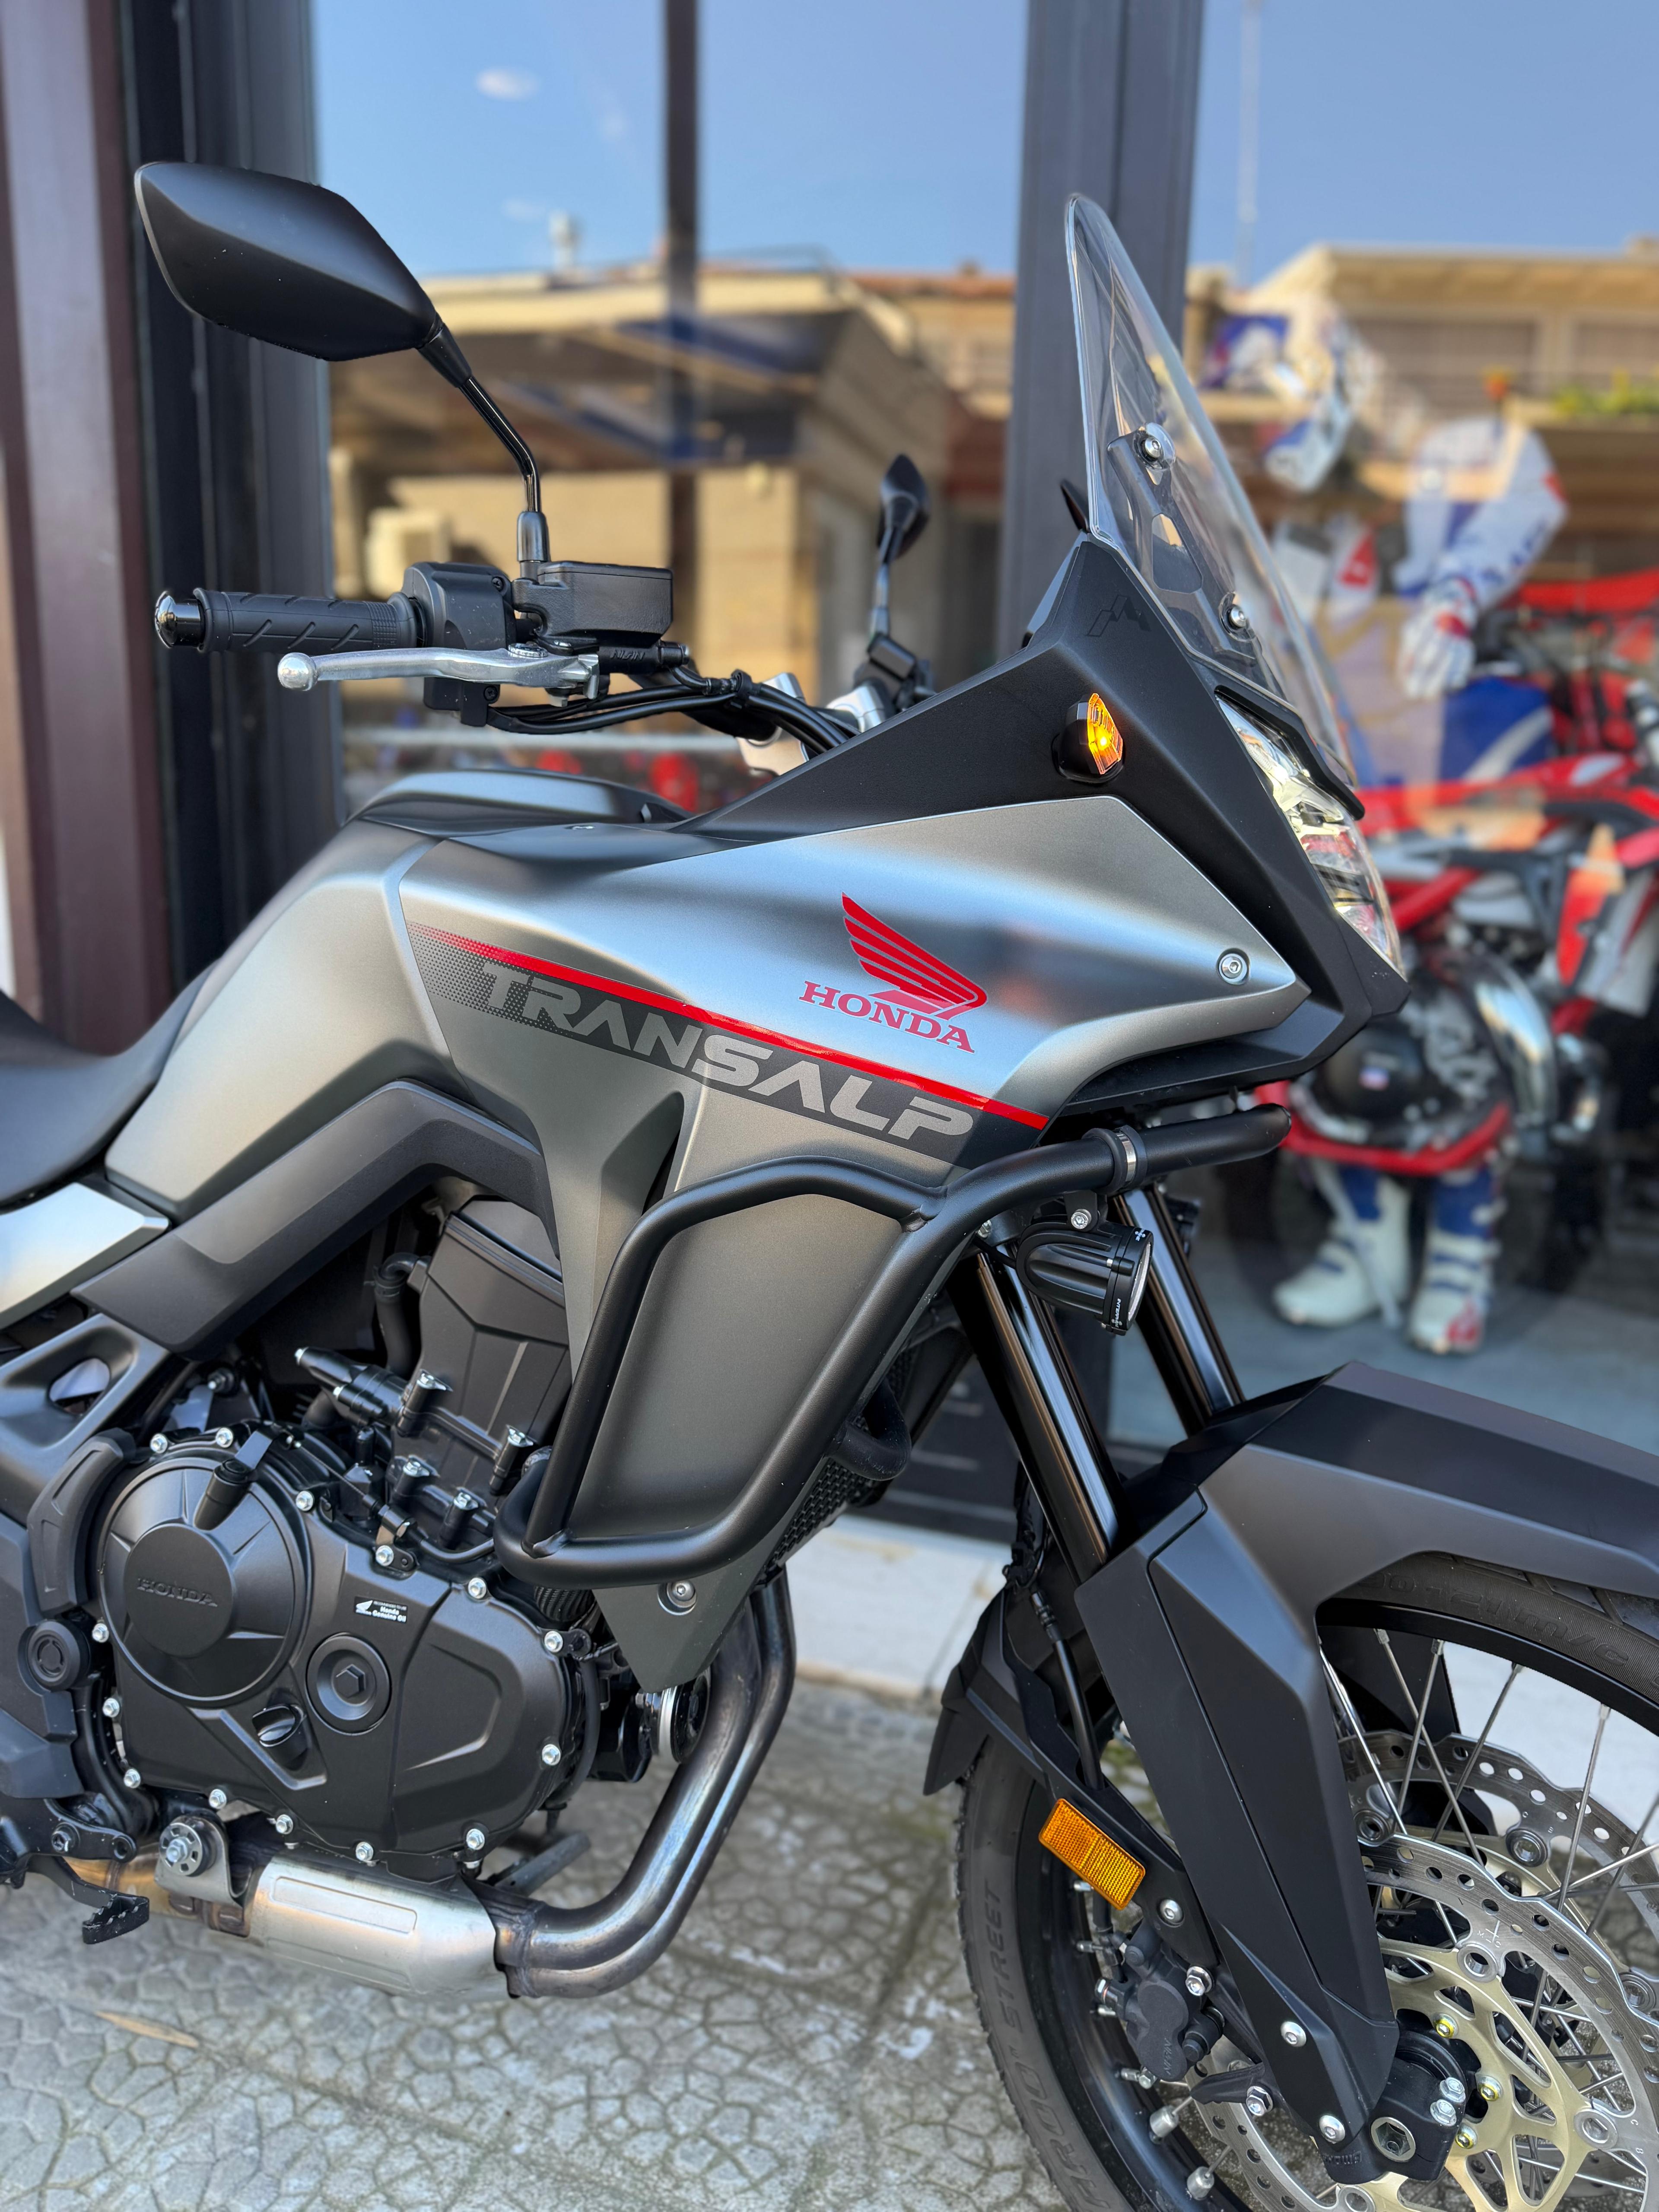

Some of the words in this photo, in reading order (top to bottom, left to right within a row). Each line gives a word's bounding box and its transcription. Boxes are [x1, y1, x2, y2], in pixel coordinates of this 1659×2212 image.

[483, 963, 974, 1141] TRANSALP
[798, 981, 975, 1053] HONDA
[137, 1578, 218, 1607] HONDA
[984, 1878, 1023, 2033] STREET
